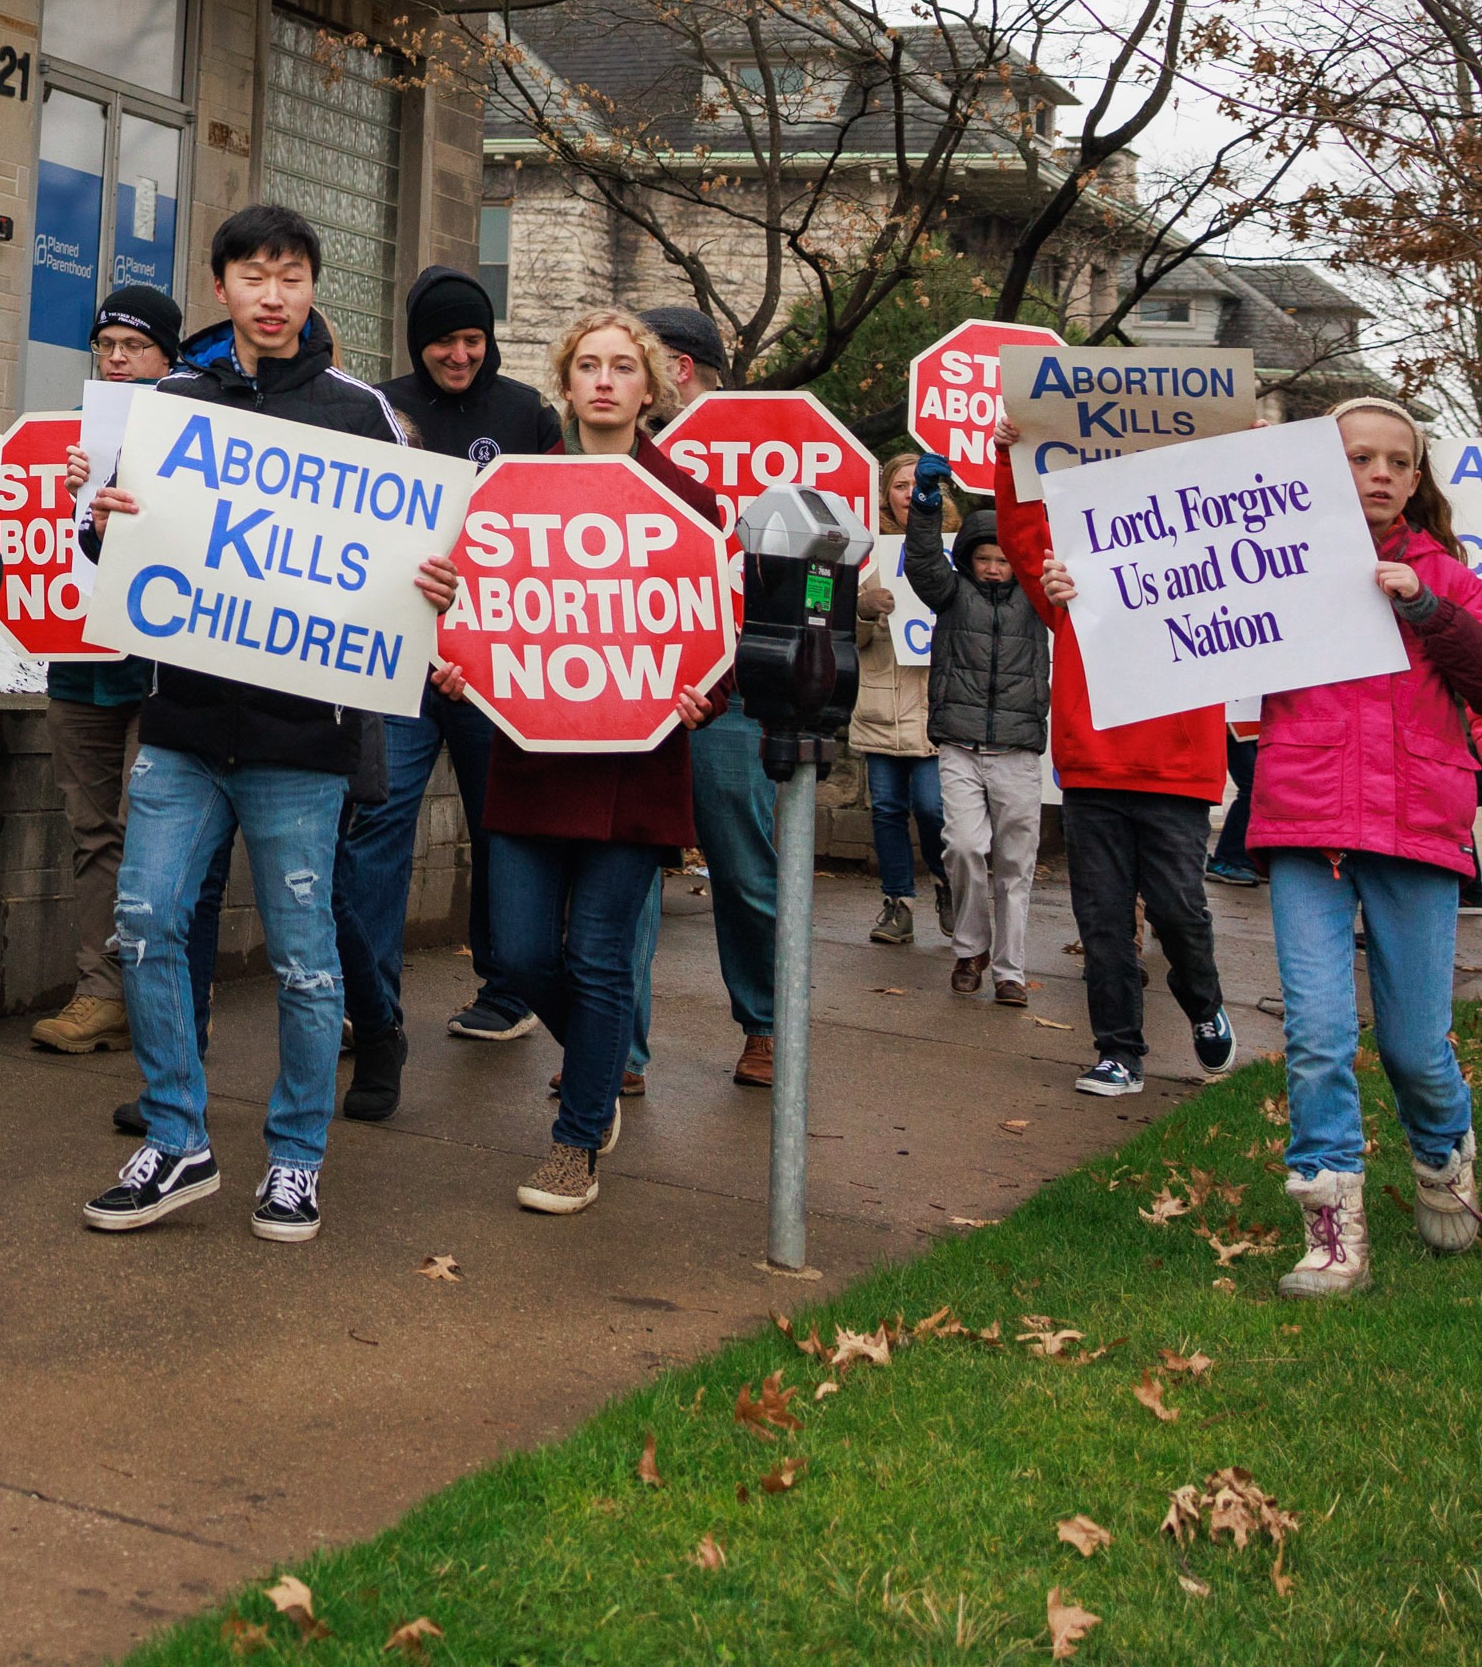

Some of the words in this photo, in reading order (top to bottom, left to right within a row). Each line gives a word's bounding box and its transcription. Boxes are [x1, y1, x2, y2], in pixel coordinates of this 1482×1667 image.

[46, 254, 91, 278] Parenthood
[47, 236, 79, 258] Planned
[125, 257, 155, 277] Planned
[940, 350, 1001, 388] ST
[1030, 356, 1234, 399] ABORTION
[1076, 401, 1196, 438] KILLS
[156, 414, 444, 531] ABORTION
[669, 439, 842, 487] STOP
[465, 511, 678, 569] STOP
[1081, 494, 1177, 554] Lord,
[1175, 473, 1312, 533] Forgive
[205, 498, 370, 591] KILLS
[5, 572, 91, 621] NO
[1110, 562, 1159, 610] Us
[1164, 545, 1227, 601] and
[1230, 538, 1310, 584] Our
[126, 564, 403, 680] CHILDREN
[443, 576, 716, 634] ABORTION
[1164, 605, 1284, 663] Nation
[491, 644, 683, 701] NOW
